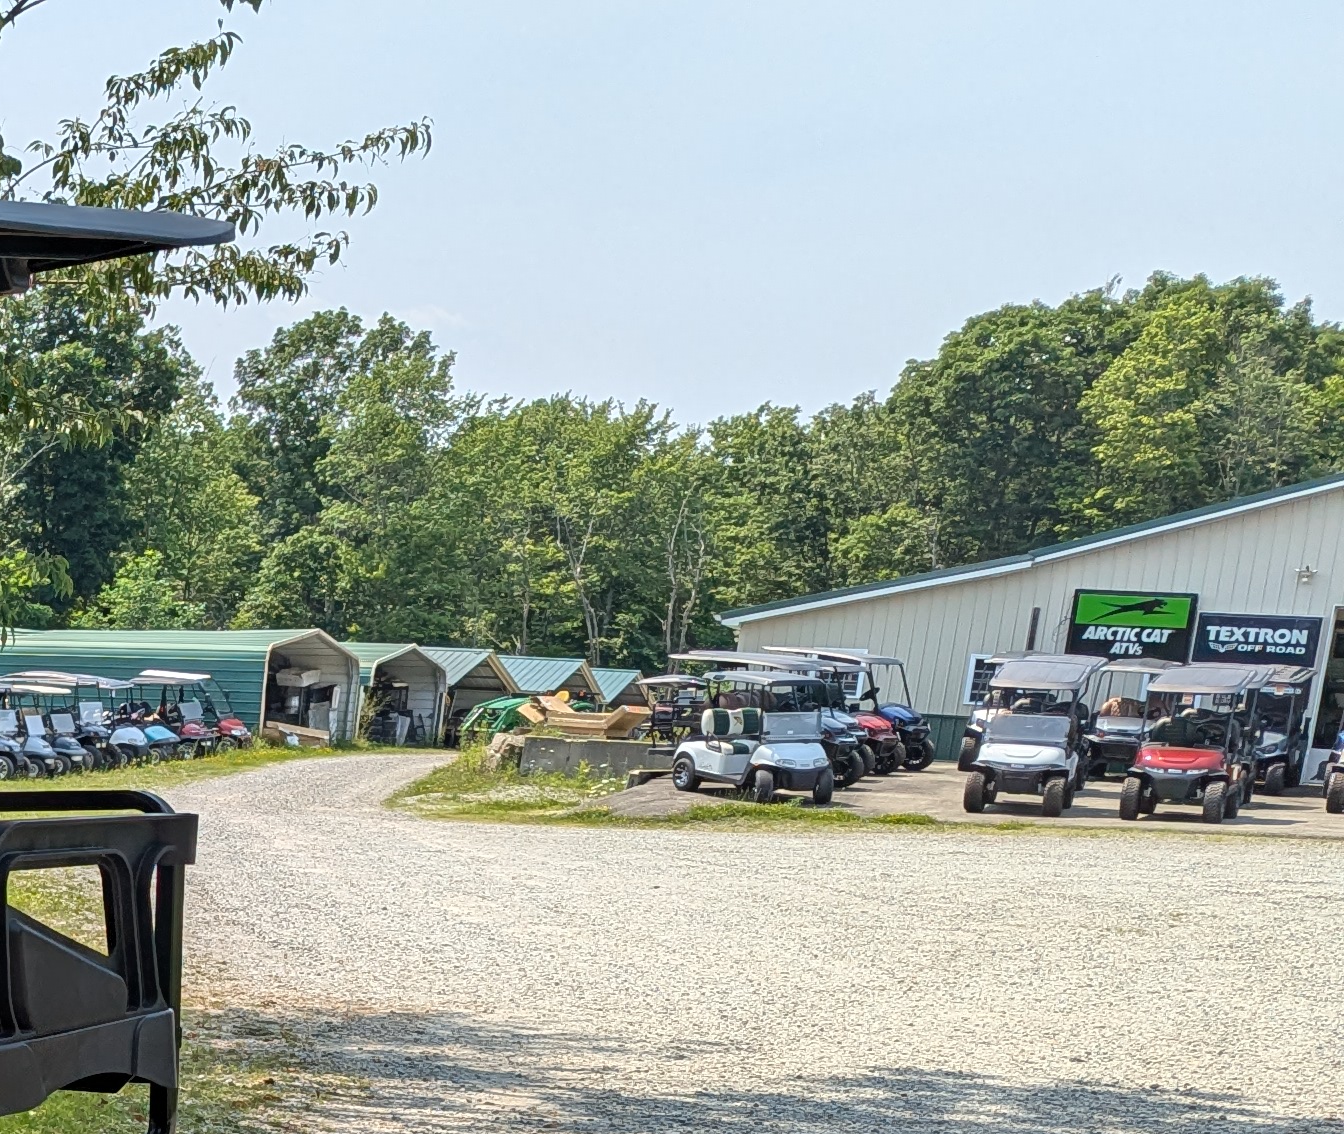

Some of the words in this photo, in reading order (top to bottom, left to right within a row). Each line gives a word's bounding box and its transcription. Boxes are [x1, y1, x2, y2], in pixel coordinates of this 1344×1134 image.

[1082, 626, 1141, 641] ARCTIC
[1141, 628, 1173, 643] CAT
[1206, 626, 1309, 644] TEXTRON
[1109, 642, 1143, 655] ATVs
[1237, 644, 1263, 653] OFF
[1266, 645, 1306, 655] ROAD
